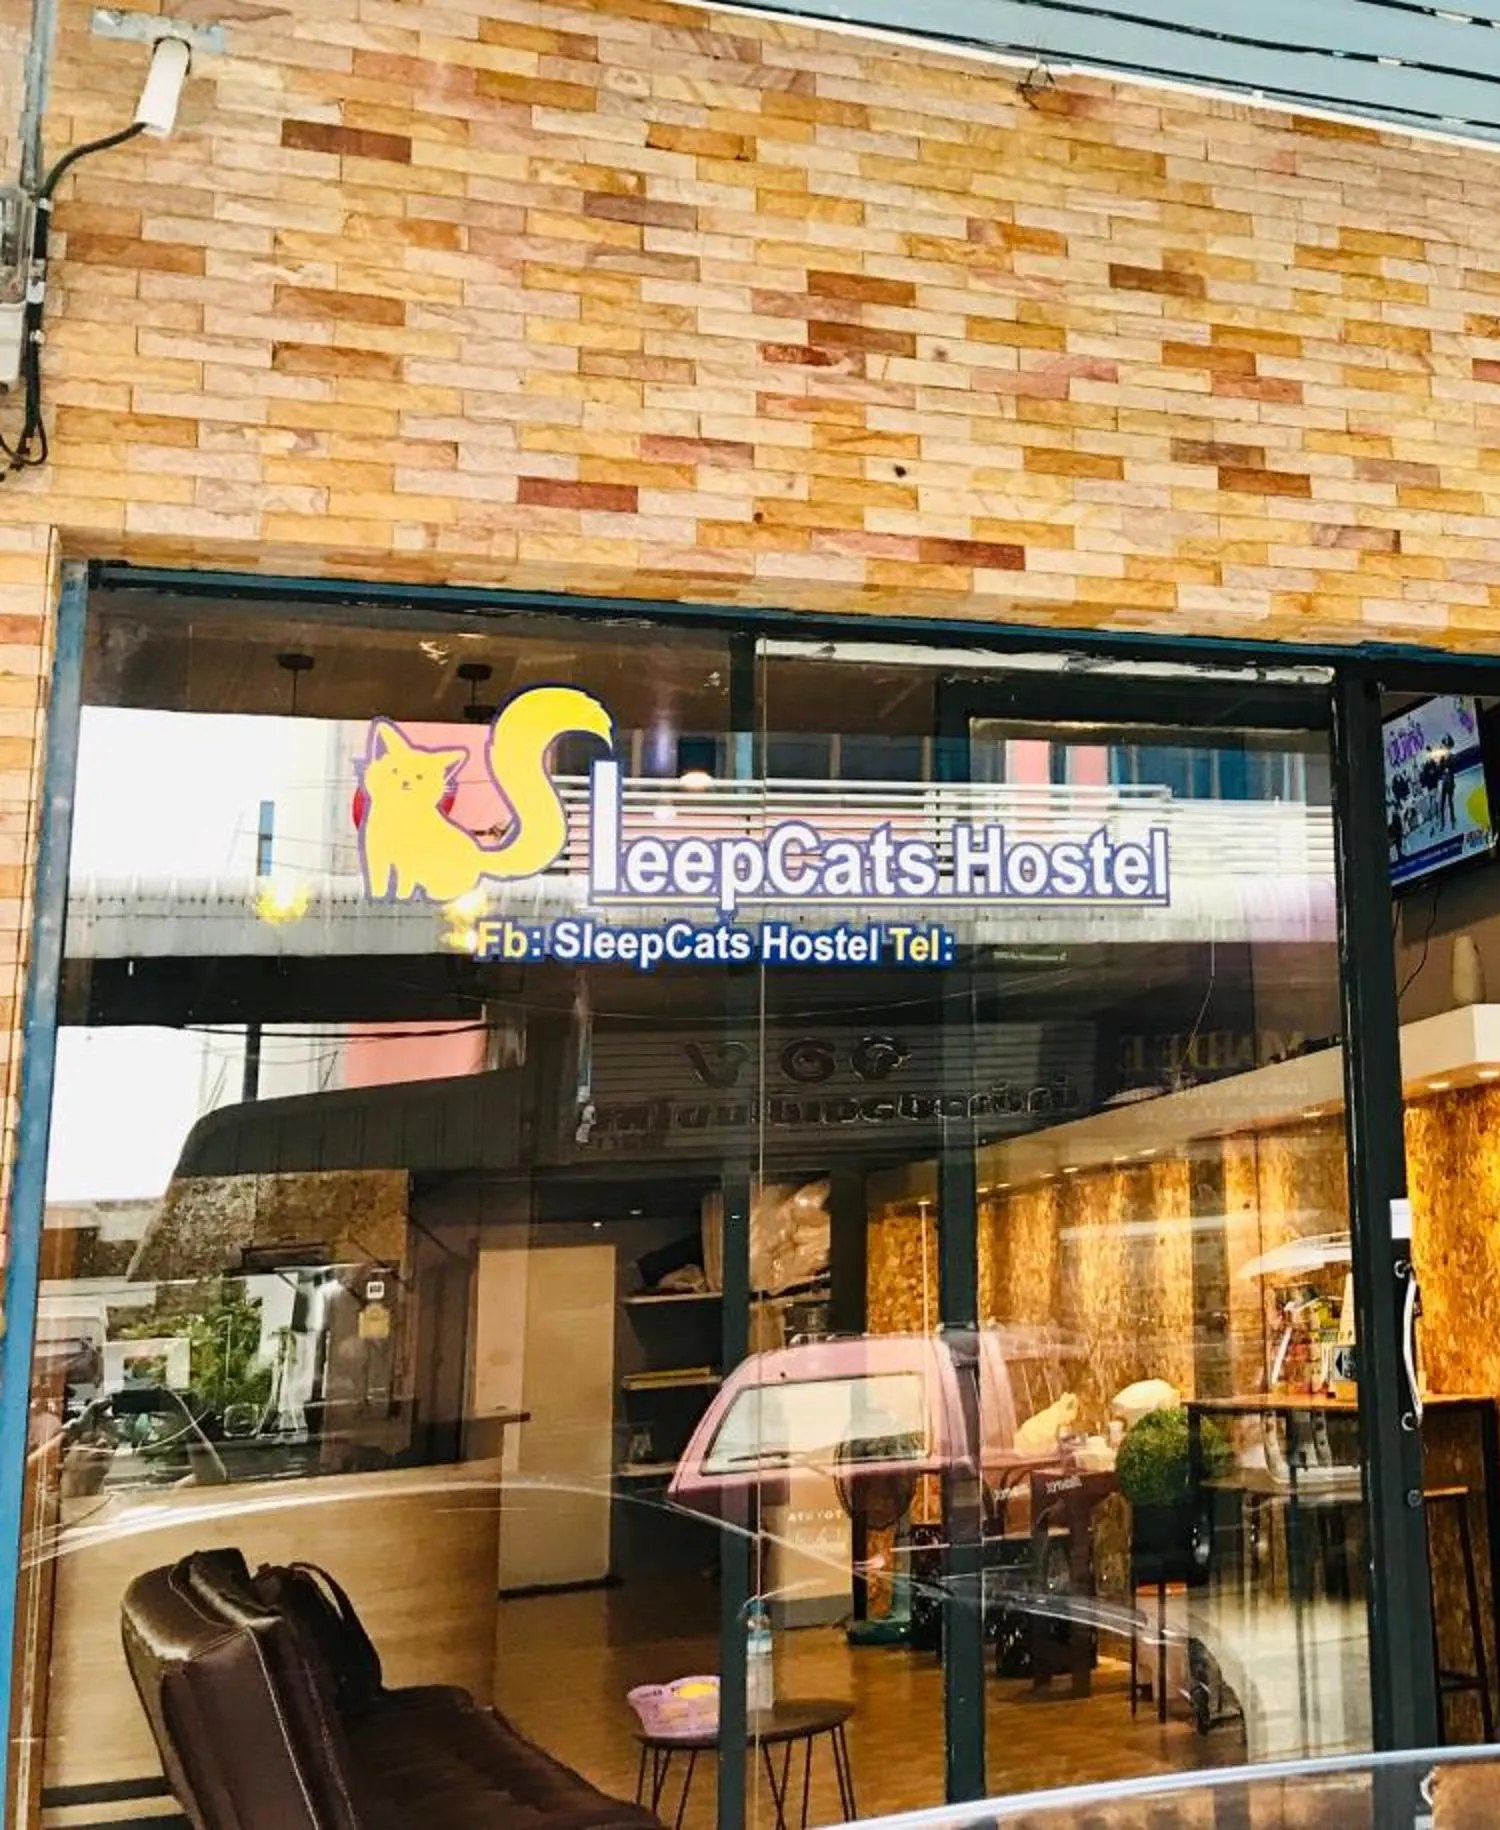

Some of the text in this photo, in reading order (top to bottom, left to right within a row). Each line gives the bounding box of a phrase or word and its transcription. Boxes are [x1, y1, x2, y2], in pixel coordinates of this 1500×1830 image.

[953, 825, 1167, 896] Hostel
[476, 921, 953, 968] Fb: SleepCats Hostel Tel:
